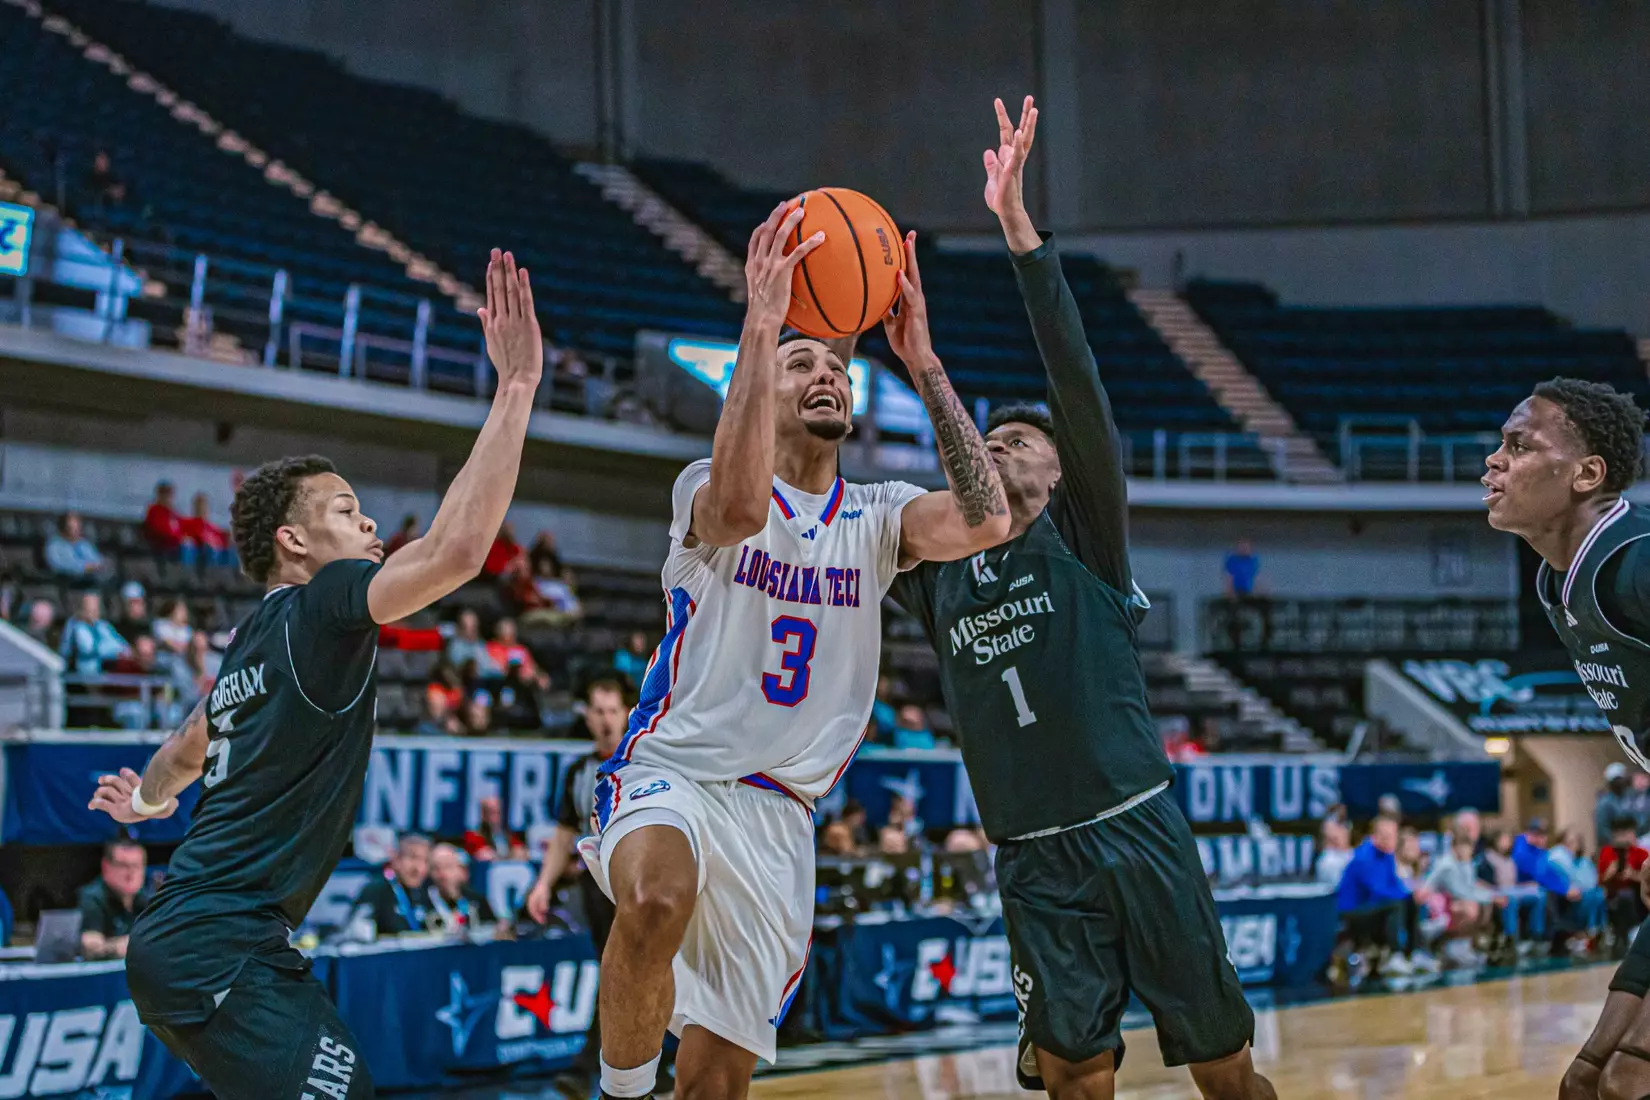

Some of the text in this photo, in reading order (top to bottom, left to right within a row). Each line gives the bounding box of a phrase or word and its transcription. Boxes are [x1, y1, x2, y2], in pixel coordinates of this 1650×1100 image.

[734, 545, 821, 605] LOUSIANA
[949, 591, 1056, 656] Missouri
[972, 624, 1035, 665] State
[761, 614, 818, 707] 3
[1574, 659, 1629, 688] issouri
[1001, 666, 1037, 728] 1
[1188, 765, 1341, 822] ON US
[0, 999, 147, 1100] USA
[300, 1036, 356, 1100] ARS
